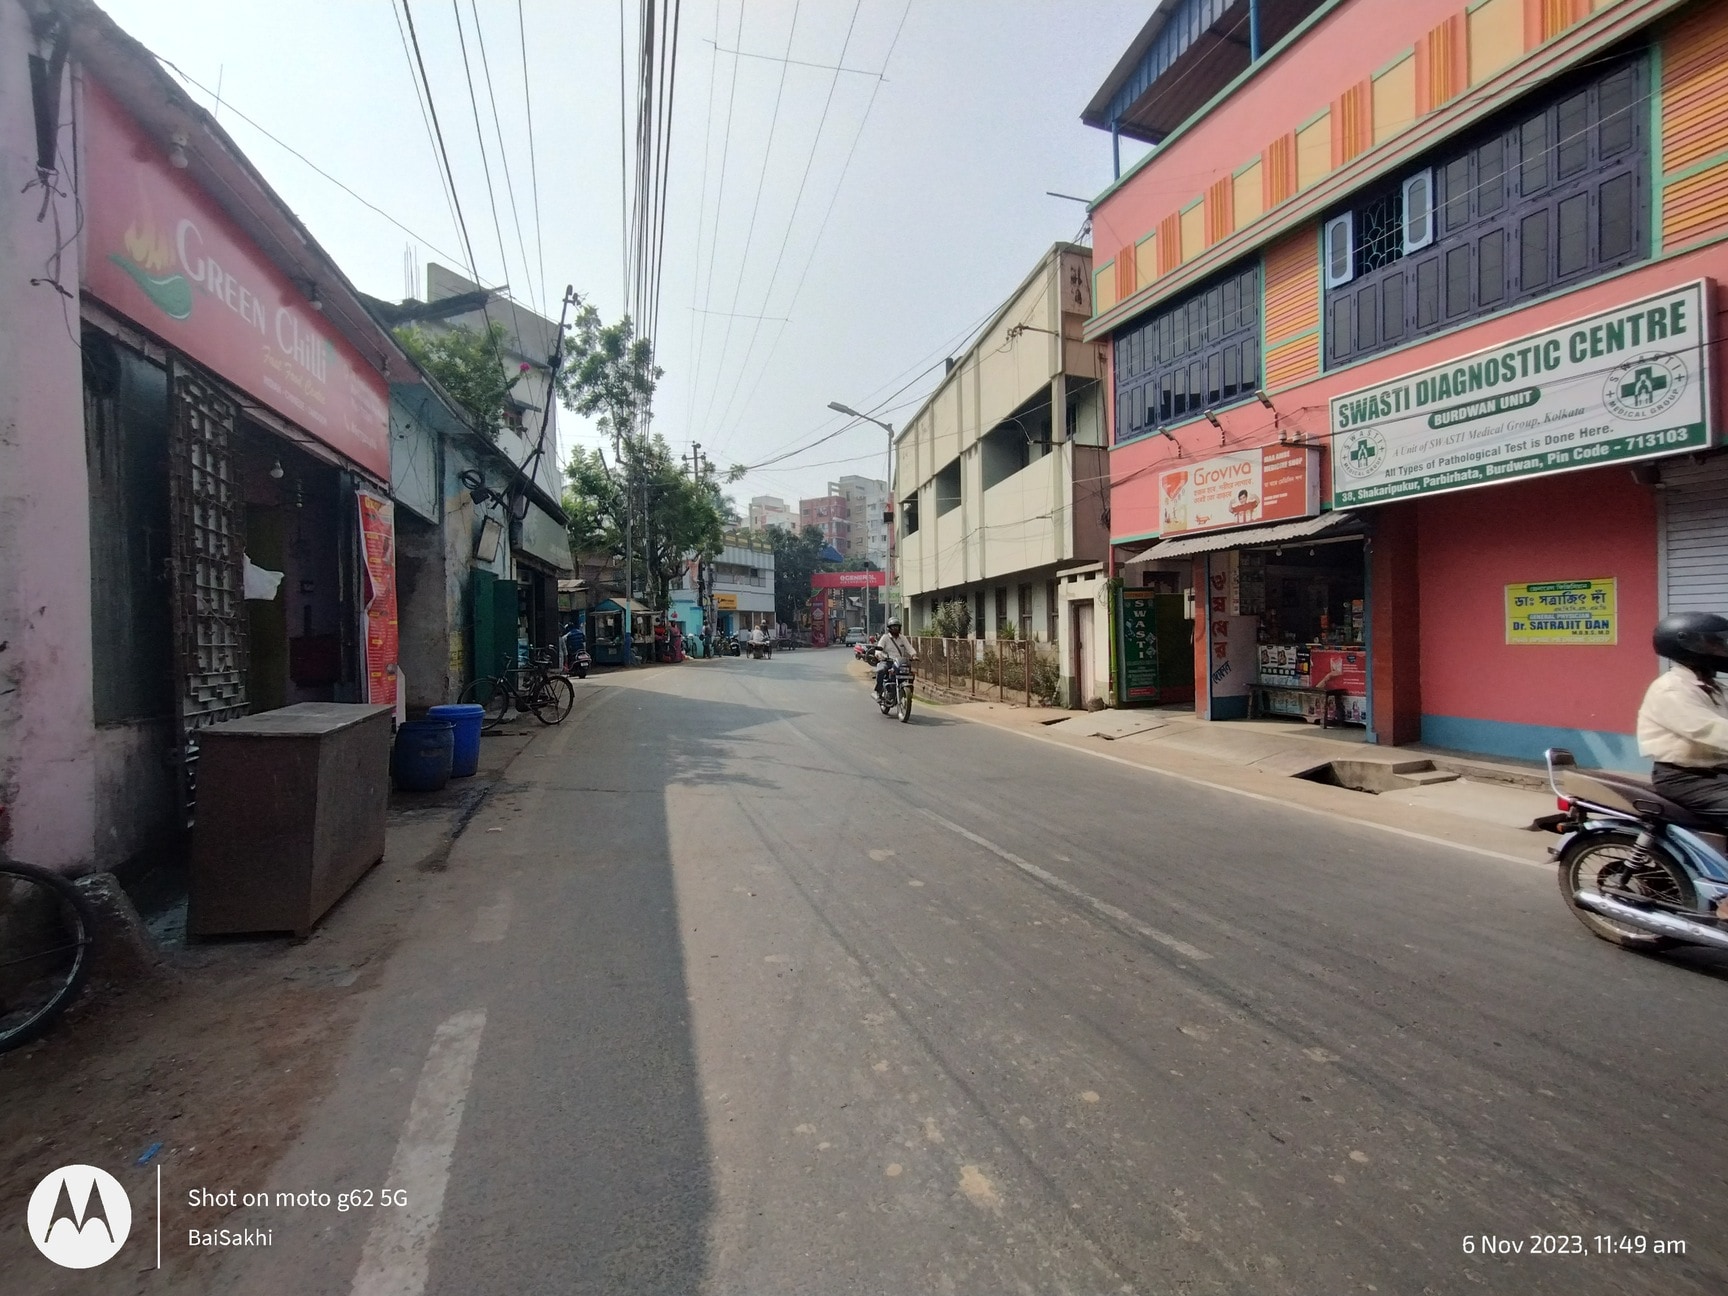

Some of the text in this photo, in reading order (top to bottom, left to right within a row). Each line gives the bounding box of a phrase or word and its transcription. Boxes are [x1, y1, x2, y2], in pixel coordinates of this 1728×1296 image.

[1339, 299, 1686, 428] SWASTI DIAGNOSTIC CENTRE
[1434, 391, 1533, 426] BURDWAN UNIT
[1609, 388, 1679, 417] MEDICAL GROUP
[1344, 430, 1382, 449] SWASTI
[1385, 425, 1614, 478] All Types of Pathological Test is Done Here.
[1400, 444, 1417, 457] Unit
[1418, 441, 1429, 453] of
[1429, 434, 1465, 450] SWASTI
[1469, 421, 1504, 441] Medical
[1544, 407, 1585, 424] Kolkata
[1194, 462, 1251, 486] Groviva
[1342, 491, 1356, 502] 38,
[1358, 480, 1420, 499] Shakaripukur,
[1423, 469, 1482, 487] Parbirhata,
[1486, 458, 1543, 475] Burdwan,
[1548, 450, 1569, 464] Pin
[1573, 444, 1609, 460] Code
[1625, 428, 1689, 450] 713103
[1134, 600, 1147, 659] SWASTI
[1513, 620, 1609, 630] Dr. SATRAJIT DAN
